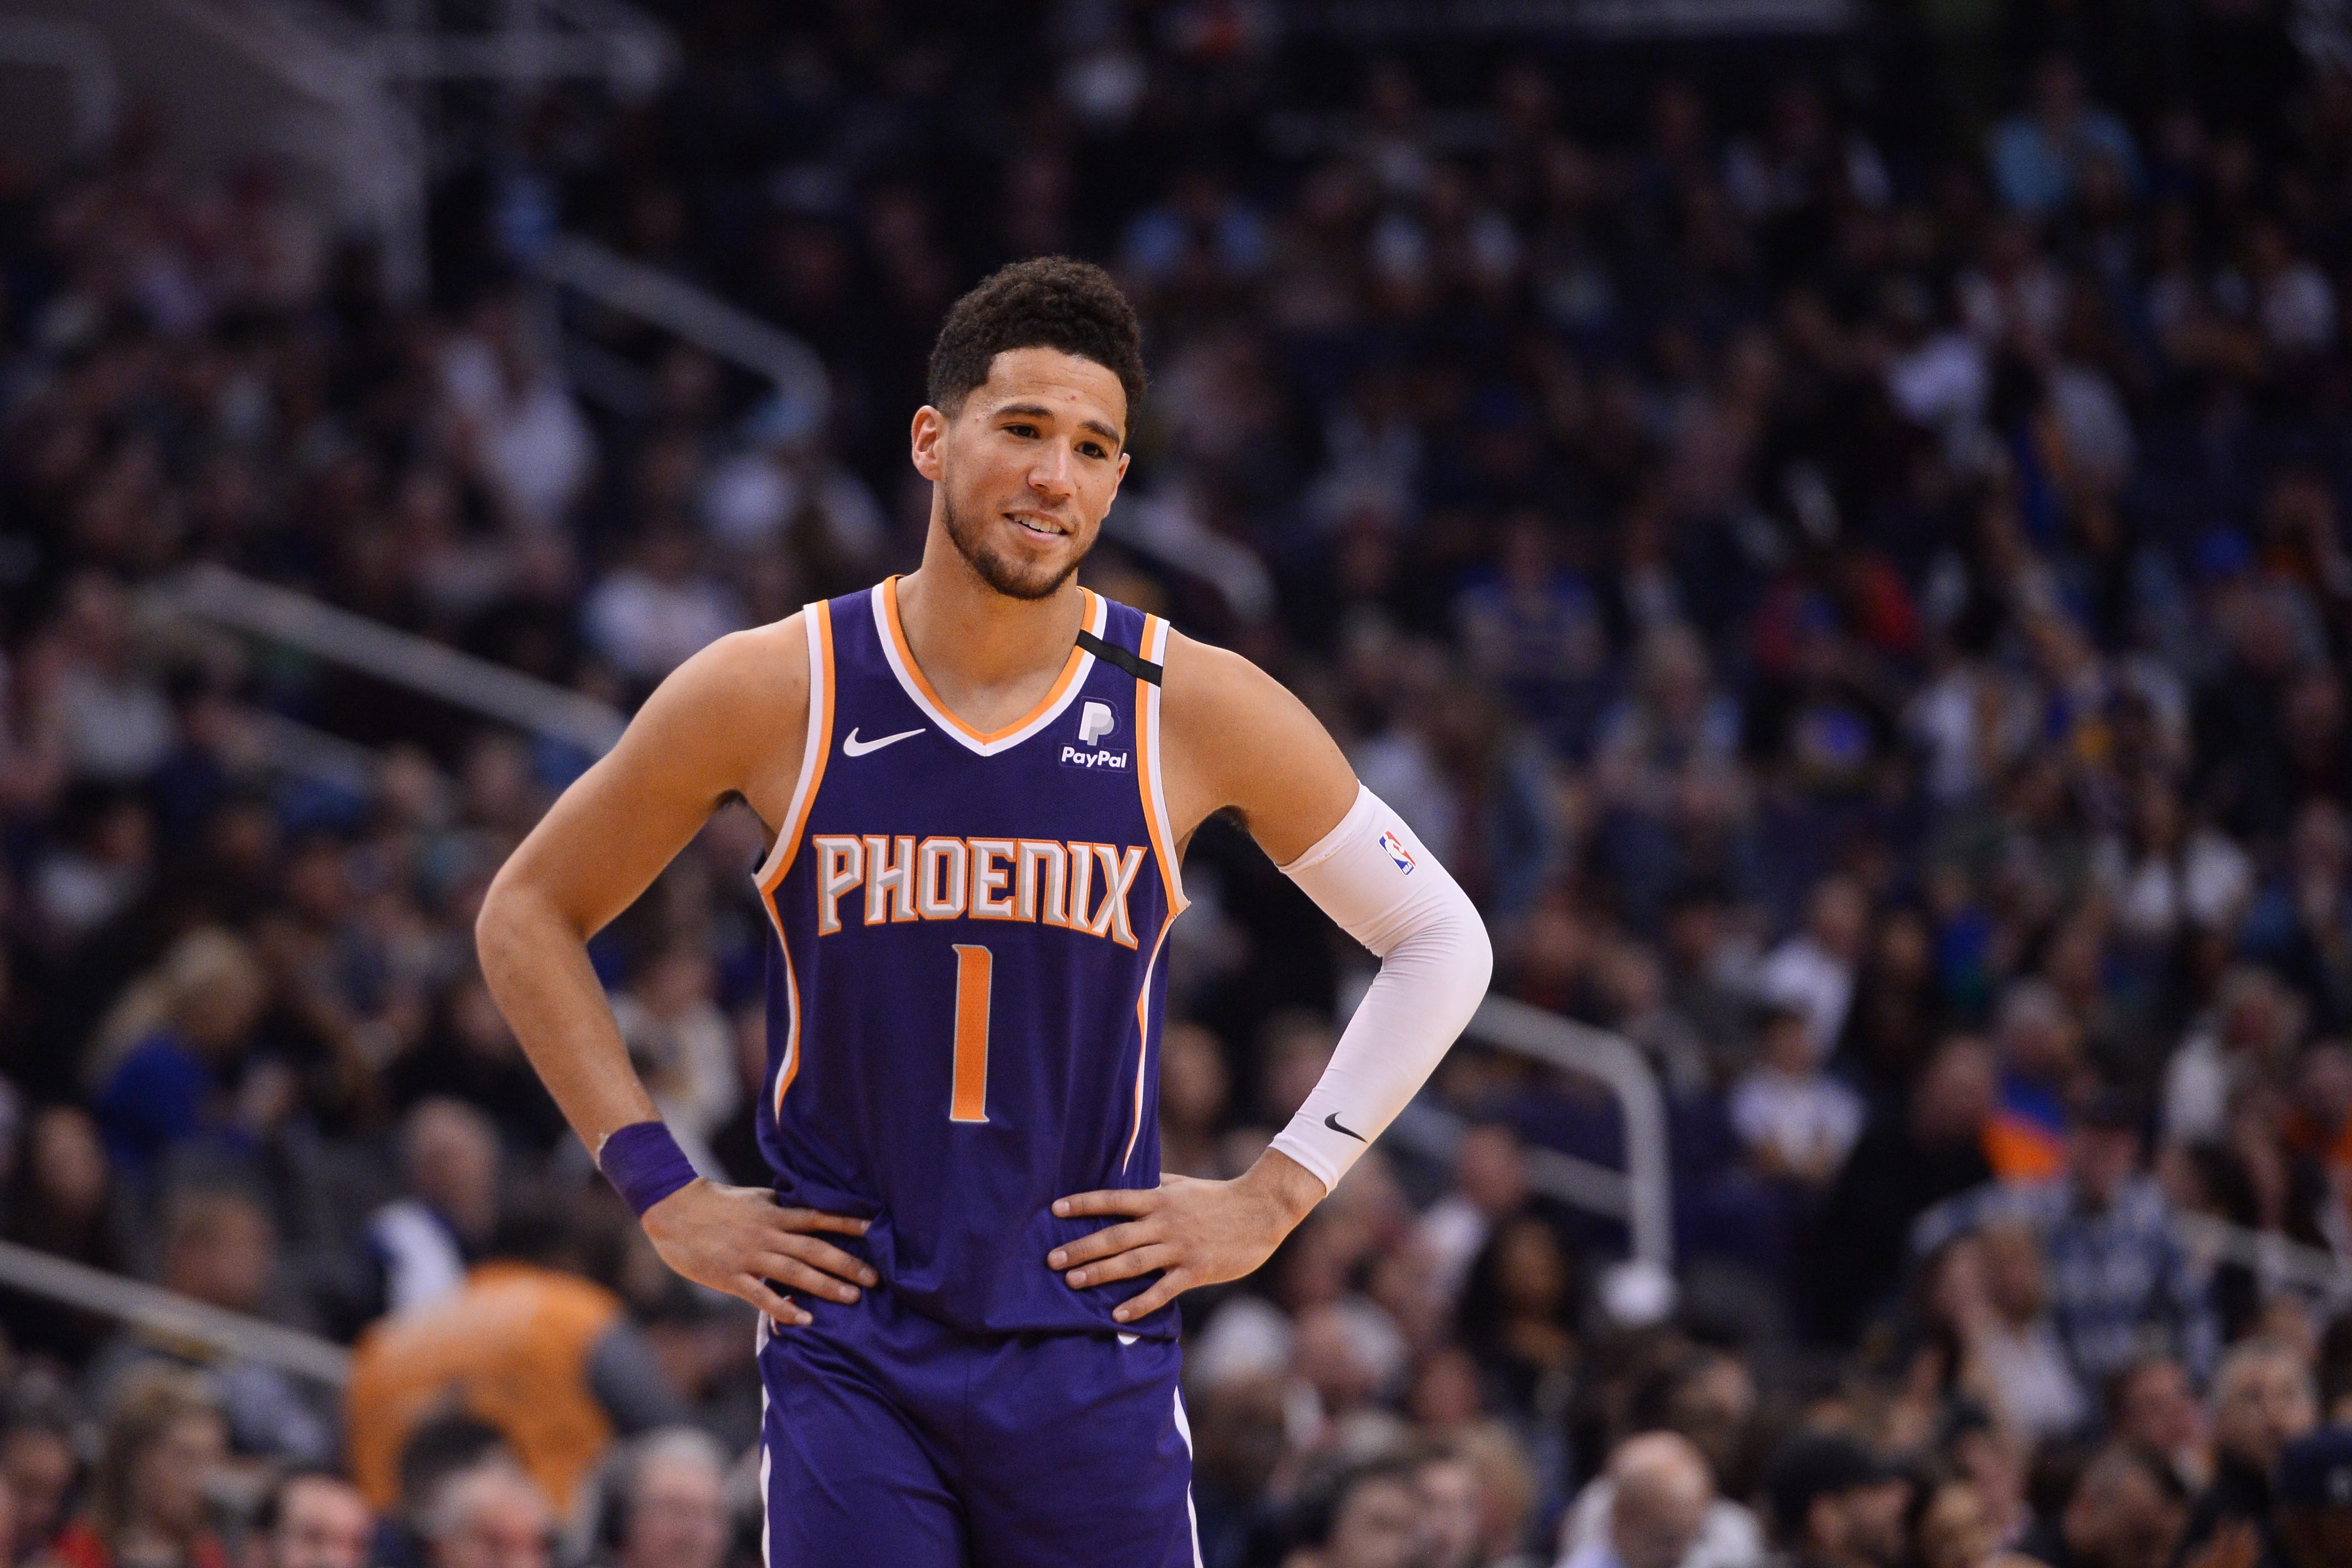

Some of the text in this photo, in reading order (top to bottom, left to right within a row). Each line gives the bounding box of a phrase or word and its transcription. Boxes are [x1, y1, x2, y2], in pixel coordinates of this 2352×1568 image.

[1061, 746, 1127, 768] PayPal
[813, 835, 1148, 951] PHOENIX
[950, 944, 993, 1123] 1
